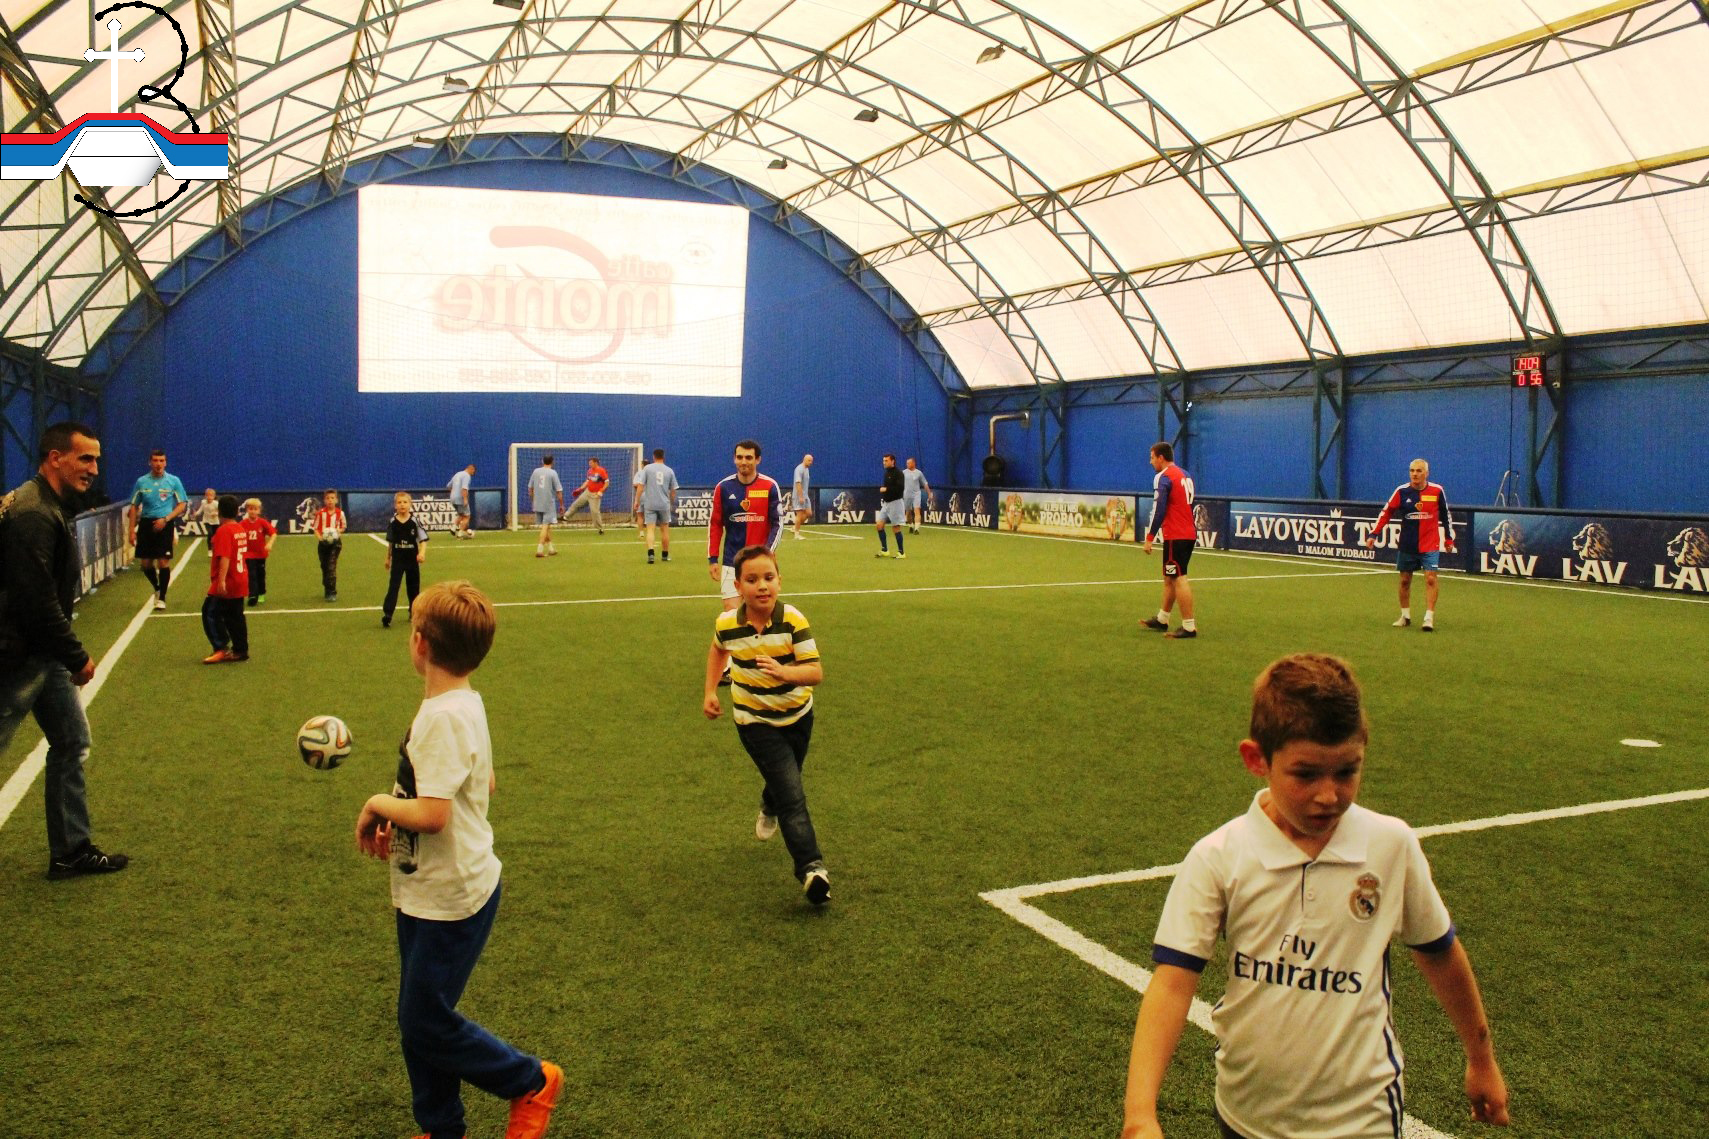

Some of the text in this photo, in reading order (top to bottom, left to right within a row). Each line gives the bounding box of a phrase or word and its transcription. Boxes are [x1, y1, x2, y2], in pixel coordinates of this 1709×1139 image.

[656, 471, 664, 485] 9
[1180, 477, 1195, 505] 19
[410, 501, 456, 512] VOVSK
[678, 498, 714, 508] LAVOV
[413, 511, 458, 524] RNI
[675, 507, 713, 520] TUR
[827, 510, 865, 523] LAV
[924, 511, 943, 524] LAV
[946, 512, 966, 525] LAV
[970, 513, 991, 527] LAV
[1040, 510, 1083, 528] PROBAO
[289, 519, 315, 534] LA
[1196, 530, 1218, 548] AV
[1234, 515, 1458, 554] LAVOVSKI TURR
[1297, 545, 1376, 560] U MALOM FUDBALU
[1480, 551, 1539, 577] LAV
[1562, 557, 1629, 584] LAV
[1279, 934, 1316, 960] Fly
[1234, 951, 1362, 994] Emirates
